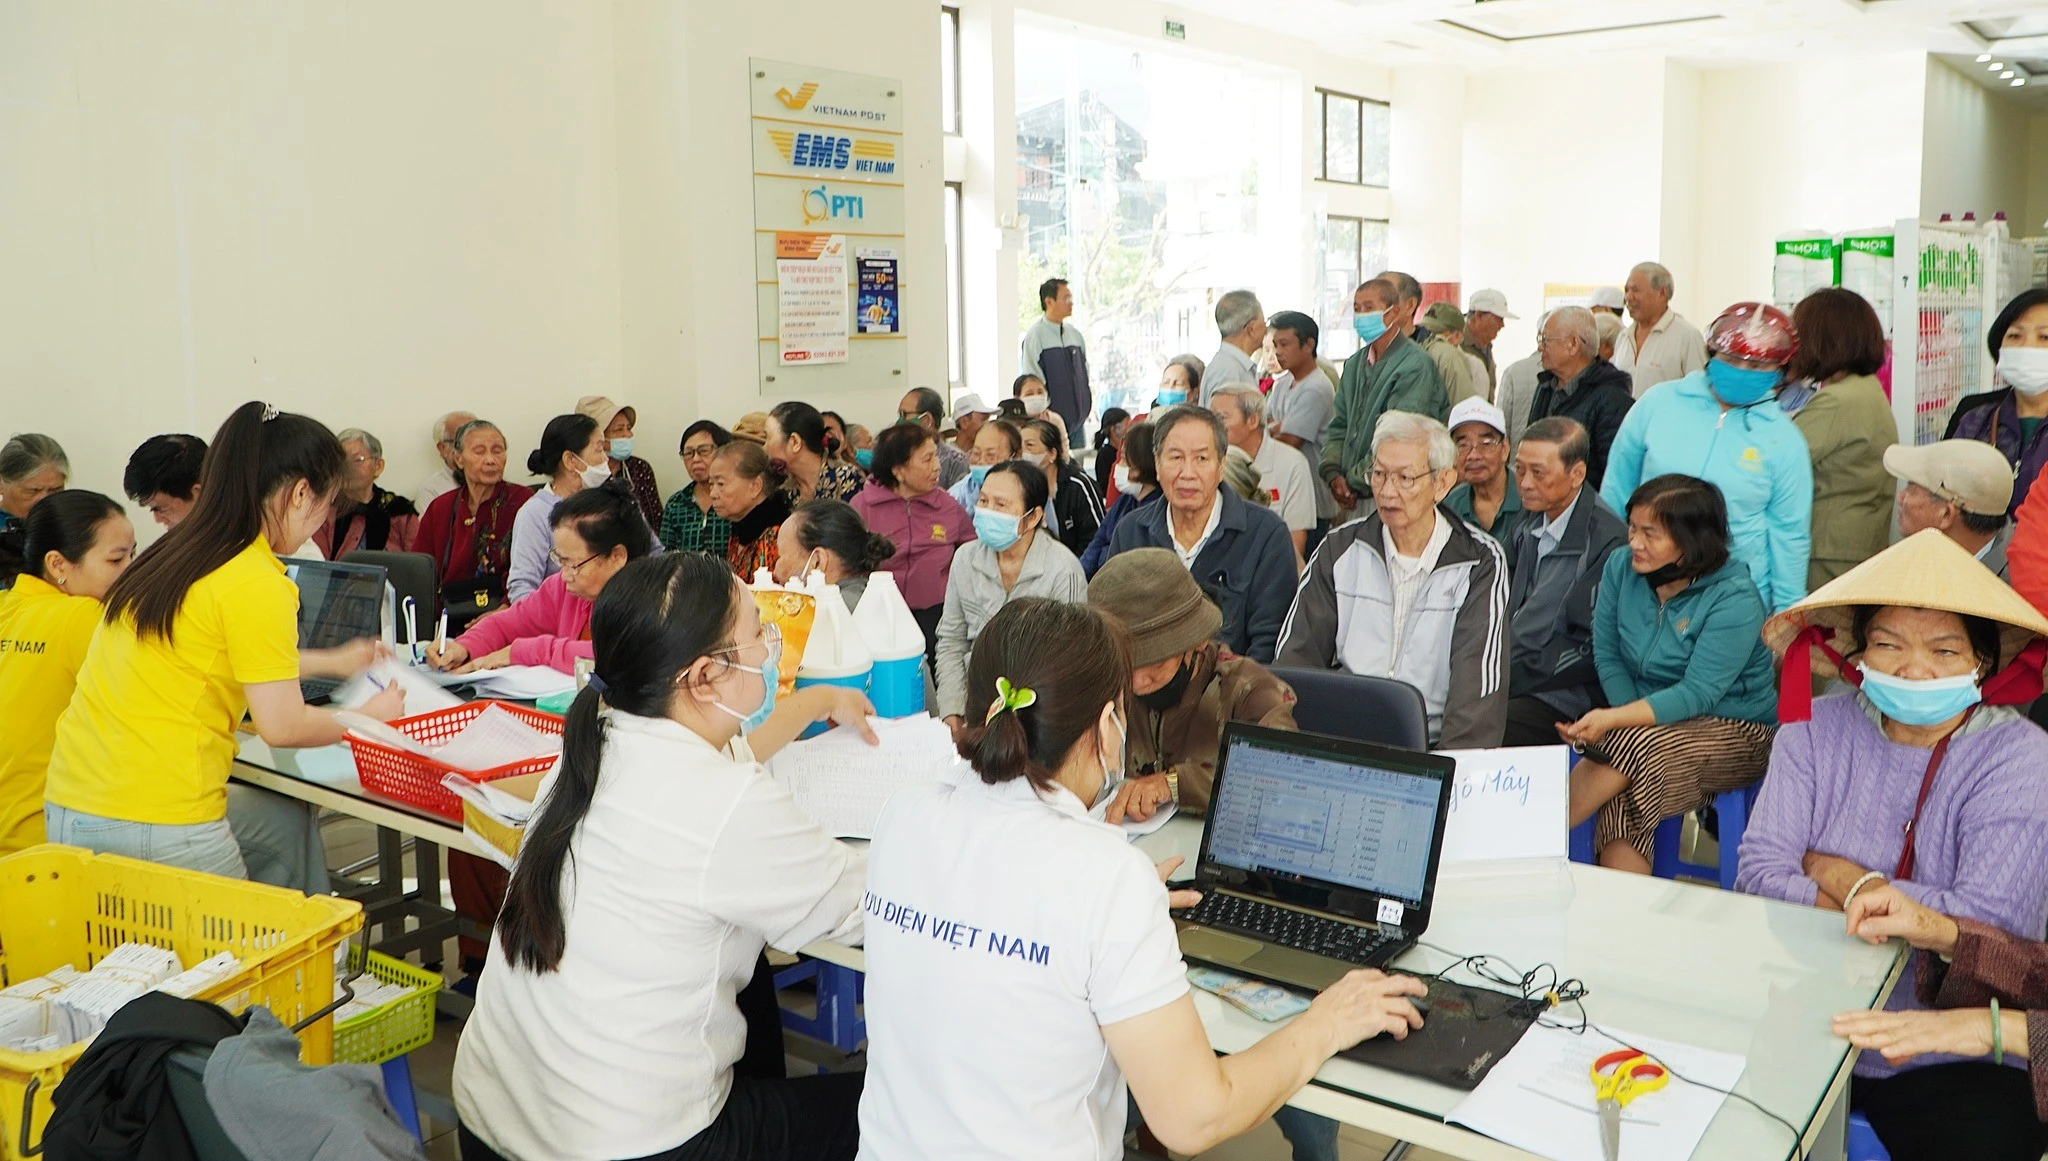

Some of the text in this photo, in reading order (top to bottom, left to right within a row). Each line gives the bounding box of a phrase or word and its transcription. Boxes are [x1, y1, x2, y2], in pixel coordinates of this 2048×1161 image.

[813, 105, 886, 121] VIETNAM POST
[793, 133, 851, 169] EMS
[856, 159, 895, 174] VIET NAM
[832, 195, 863, 219] PTI
[15, 640, 46, 655] NAM
[1481, 765, 1531, 806] Mây
[864, 888, 1050, 966] ƯU ĐIỆN VIỆT NAM
